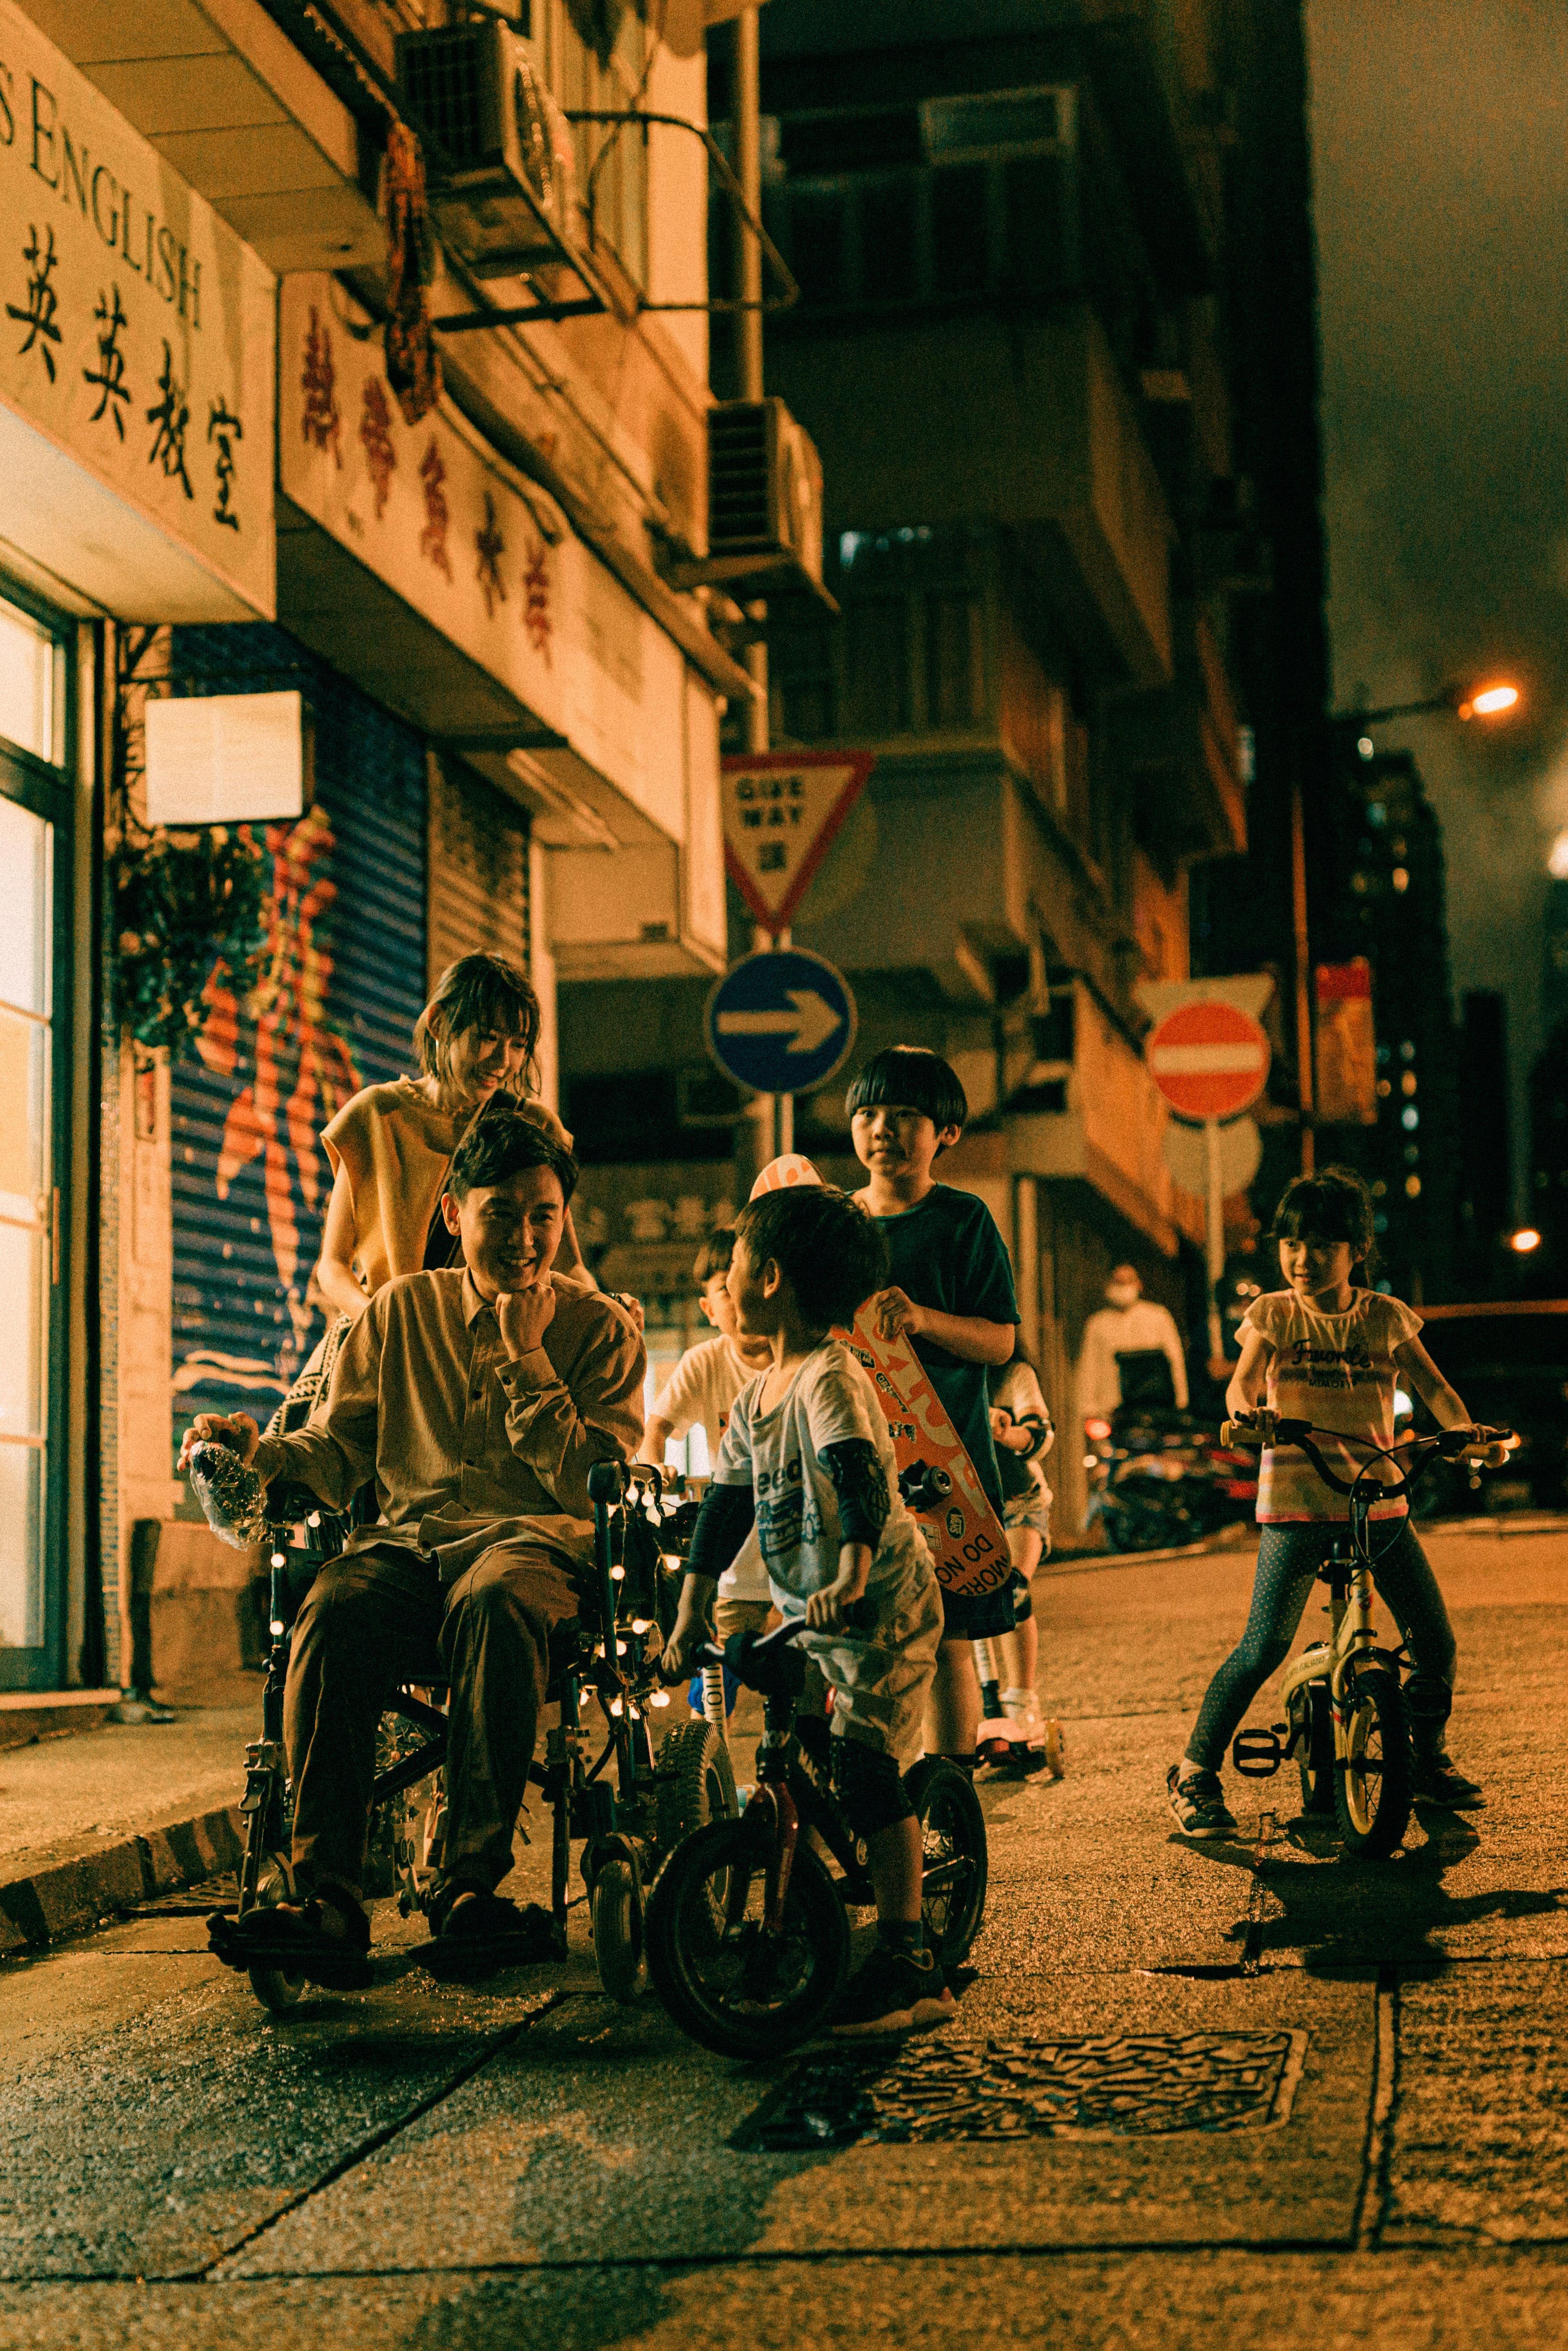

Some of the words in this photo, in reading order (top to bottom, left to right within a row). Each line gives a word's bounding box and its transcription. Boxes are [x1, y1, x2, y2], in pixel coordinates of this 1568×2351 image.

[26, 70, 202, 331] ENGLISH
[5, 223, 242, 533] 英英教室
[735, 776, 805, 801] GIVE
[740, 805, 805, 829] WAY
[962, 1533, 994, 1562] DO
